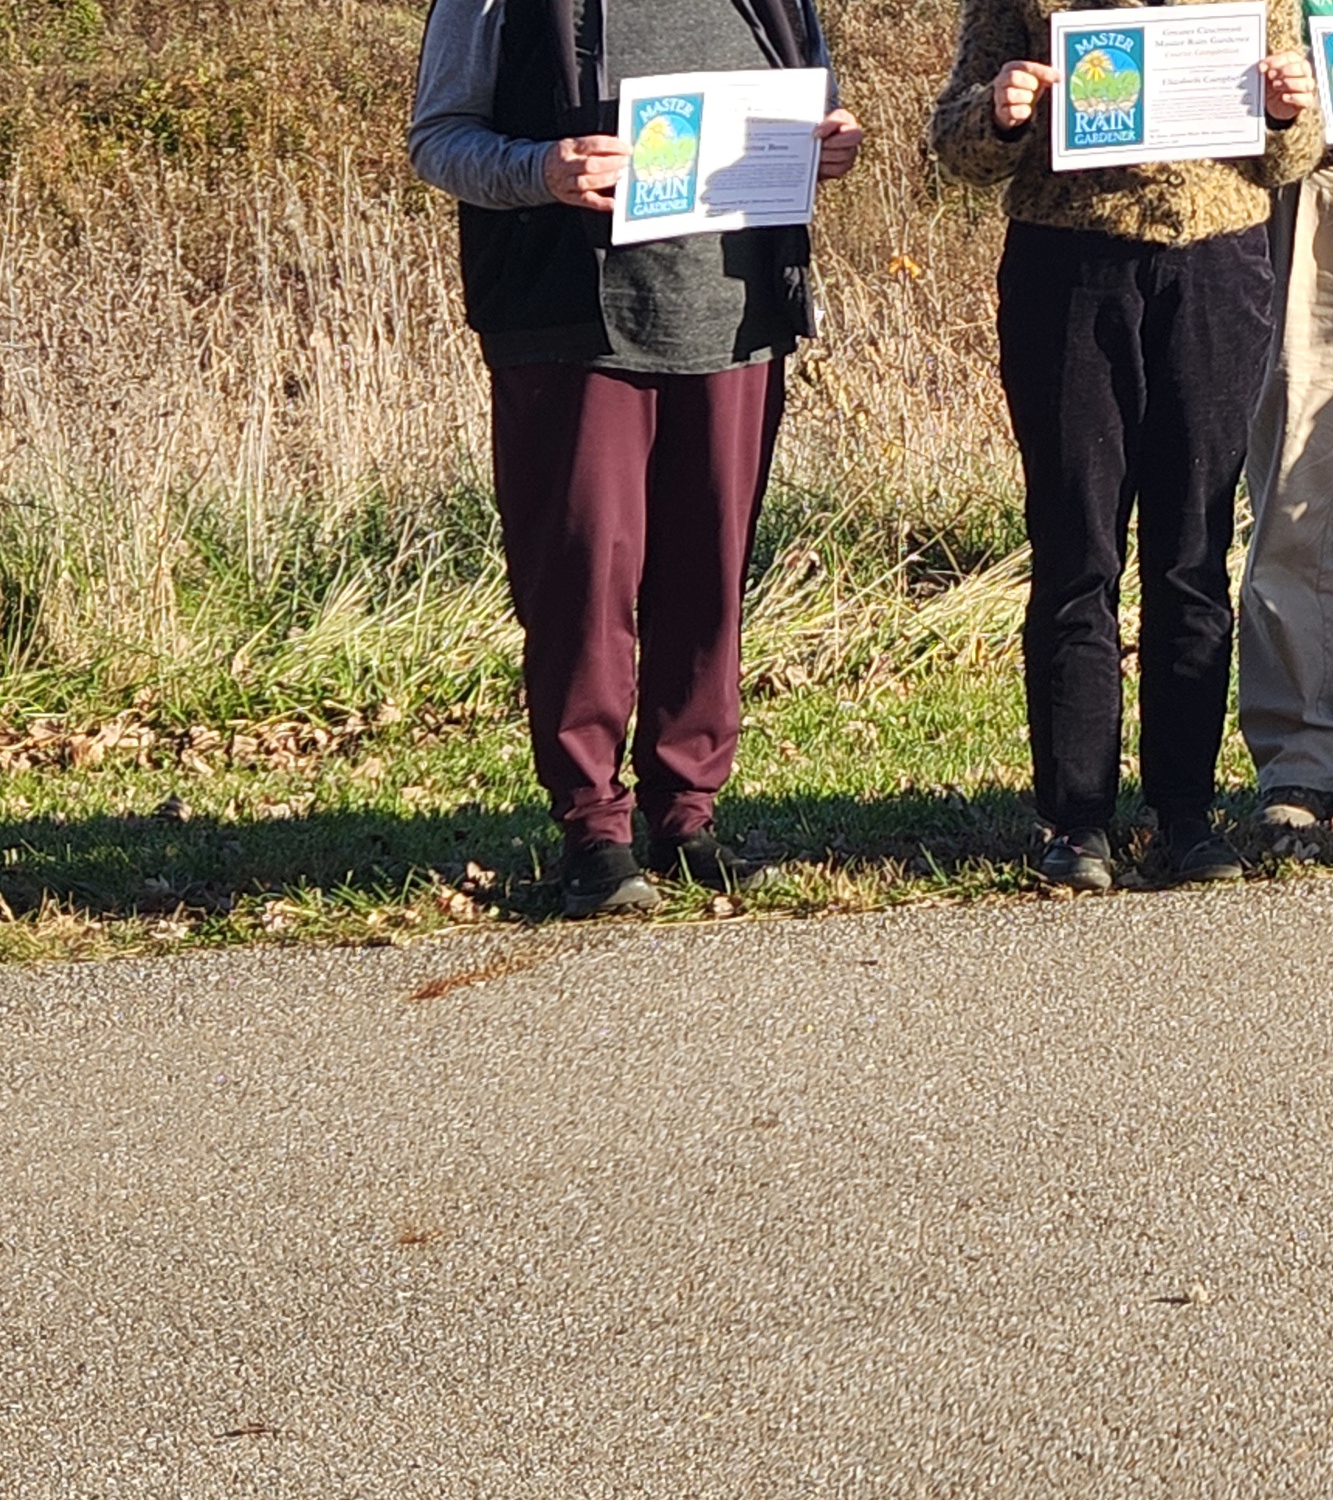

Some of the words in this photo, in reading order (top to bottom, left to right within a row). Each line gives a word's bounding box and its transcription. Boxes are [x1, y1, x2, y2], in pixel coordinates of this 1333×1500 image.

[1074, 33, 1134, 56] MASTER
[639, 98, 695, 123] MASTER
[1075, 109, 1135, 133] RAIN
[1075, 131, 1135, 144] GARDENER
[635, 176, 691, 203] RAIN
[633, 199, 688, 215] GARDENER
